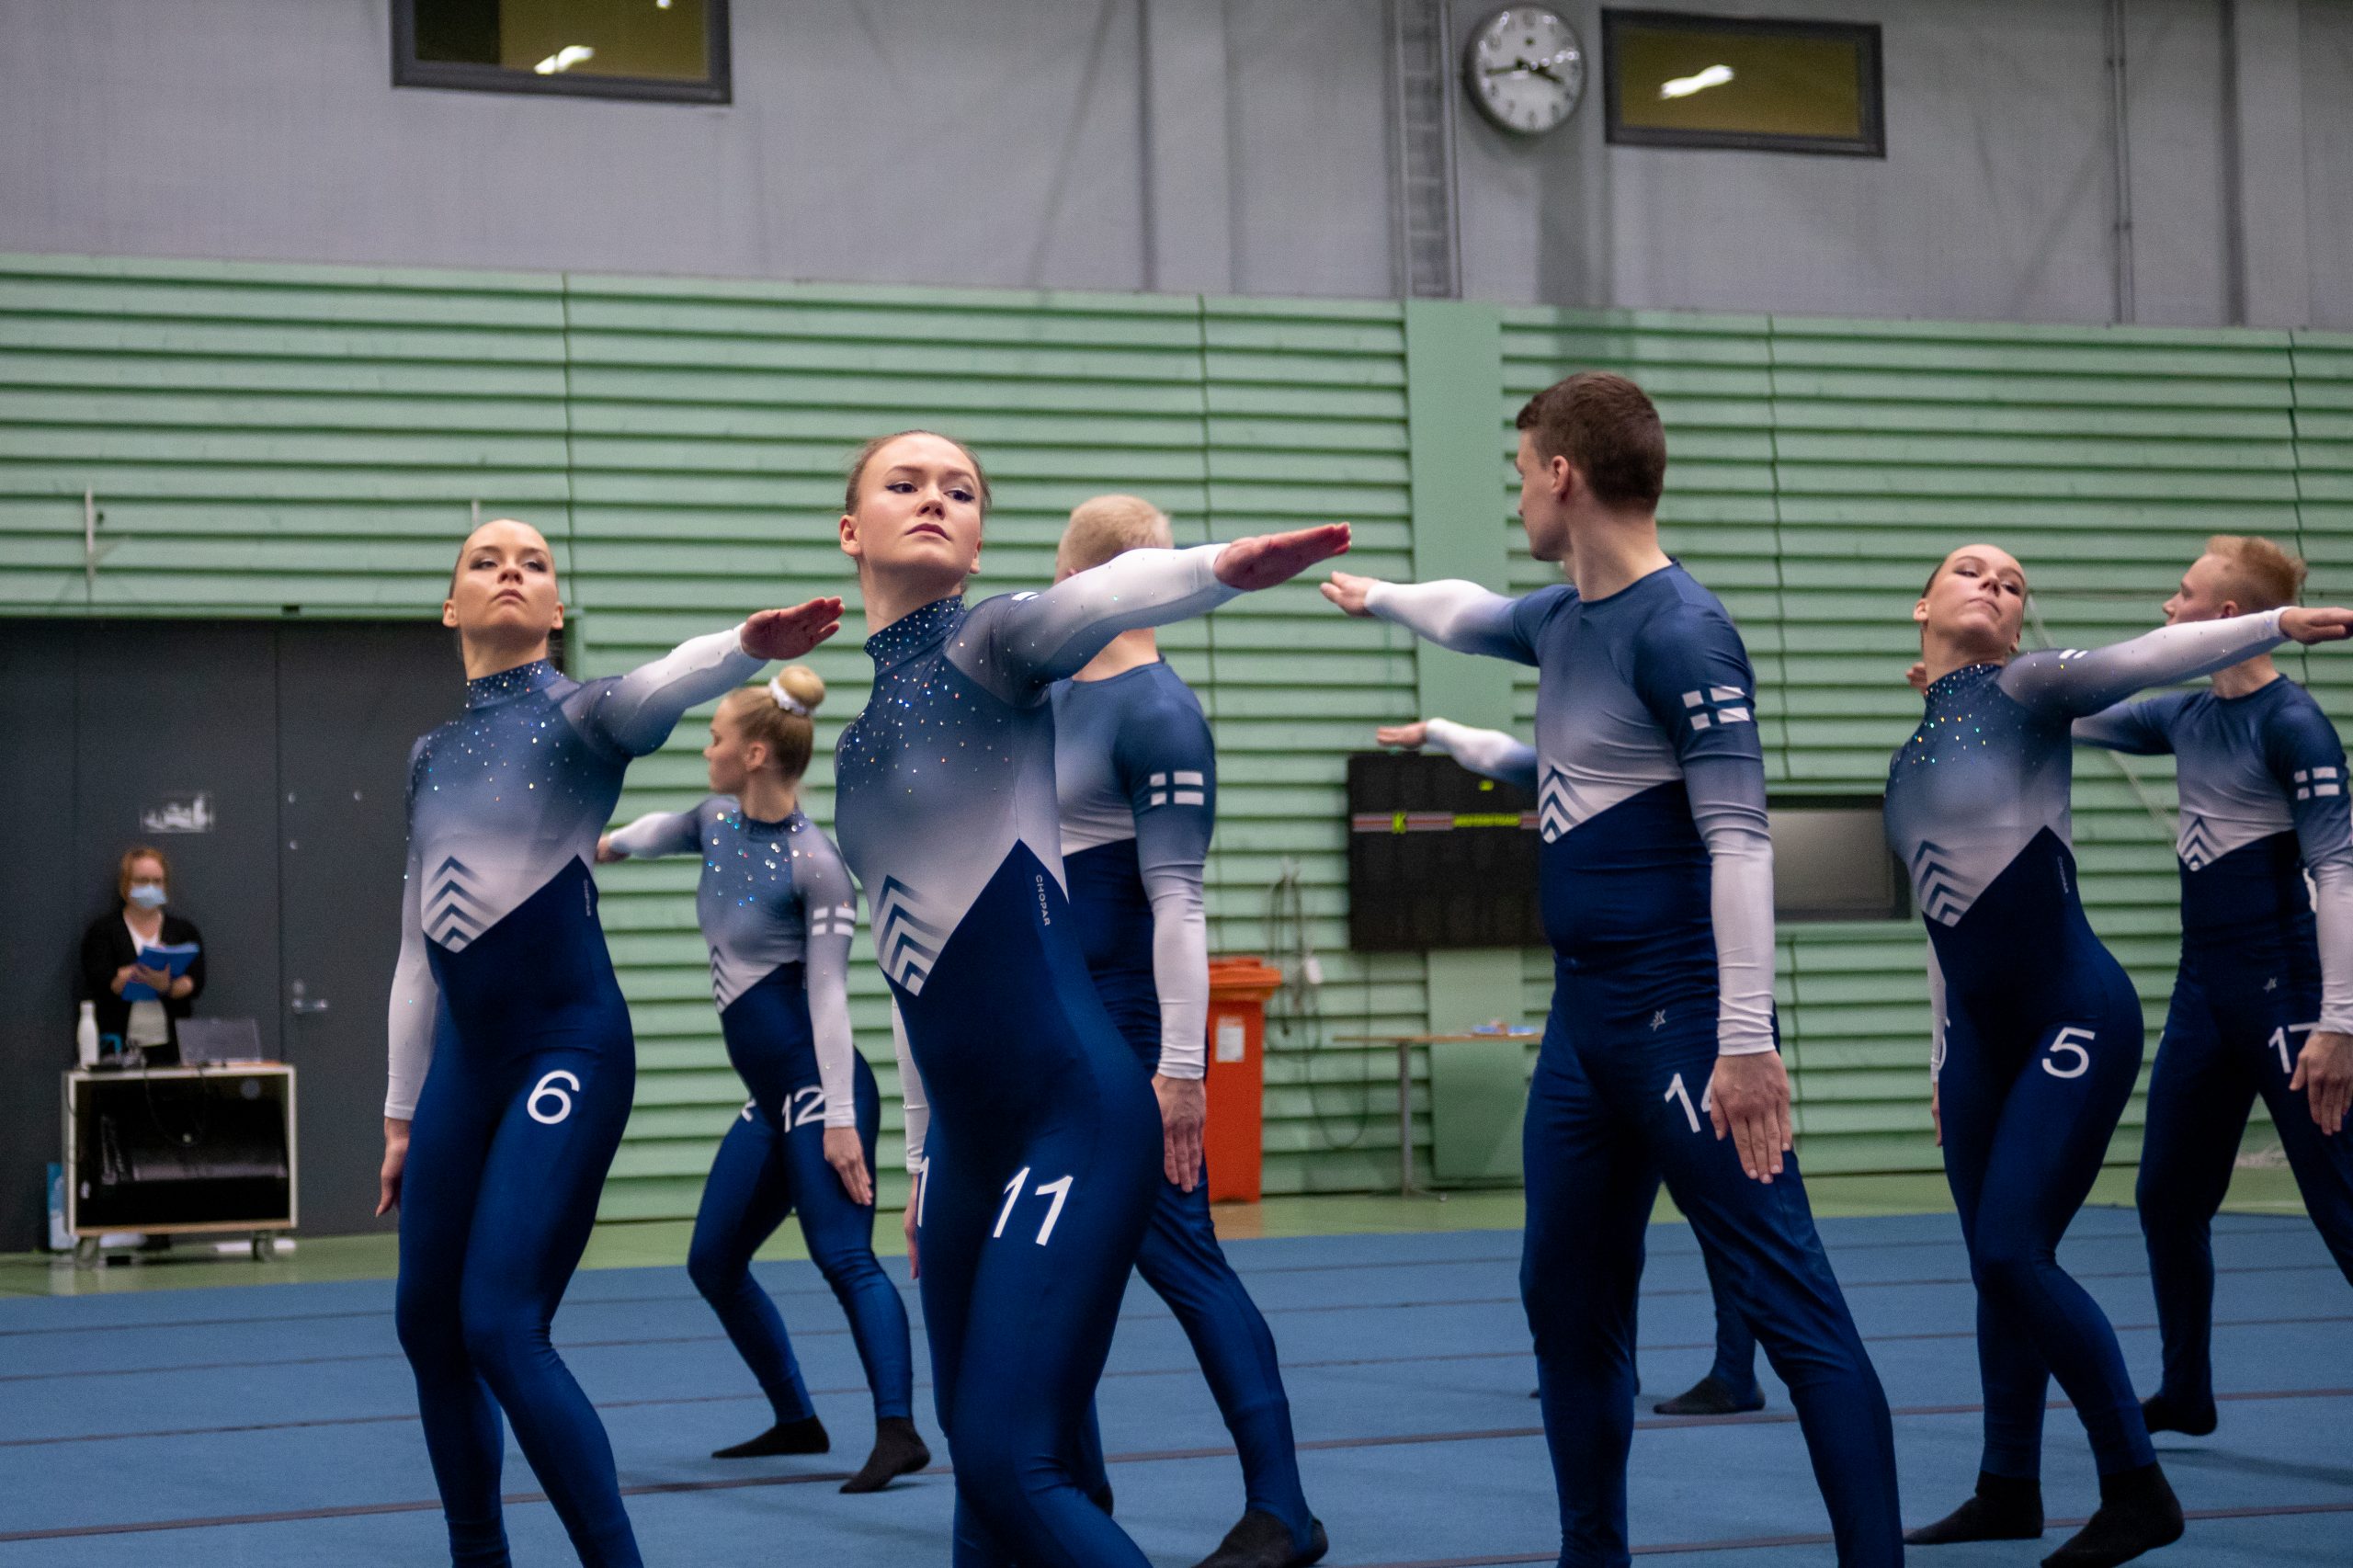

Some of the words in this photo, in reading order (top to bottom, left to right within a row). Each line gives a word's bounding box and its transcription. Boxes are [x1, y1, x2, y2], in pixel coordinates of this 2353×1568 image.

[1036, 874, 1051, 926] CHOPAR
[2041, 1027, 2096, 1079] 5
[527, 1070, 580, 1124] 6
[782, 1085, 825, 1133] 12
[993, 1166, 1074, 1246] 11
